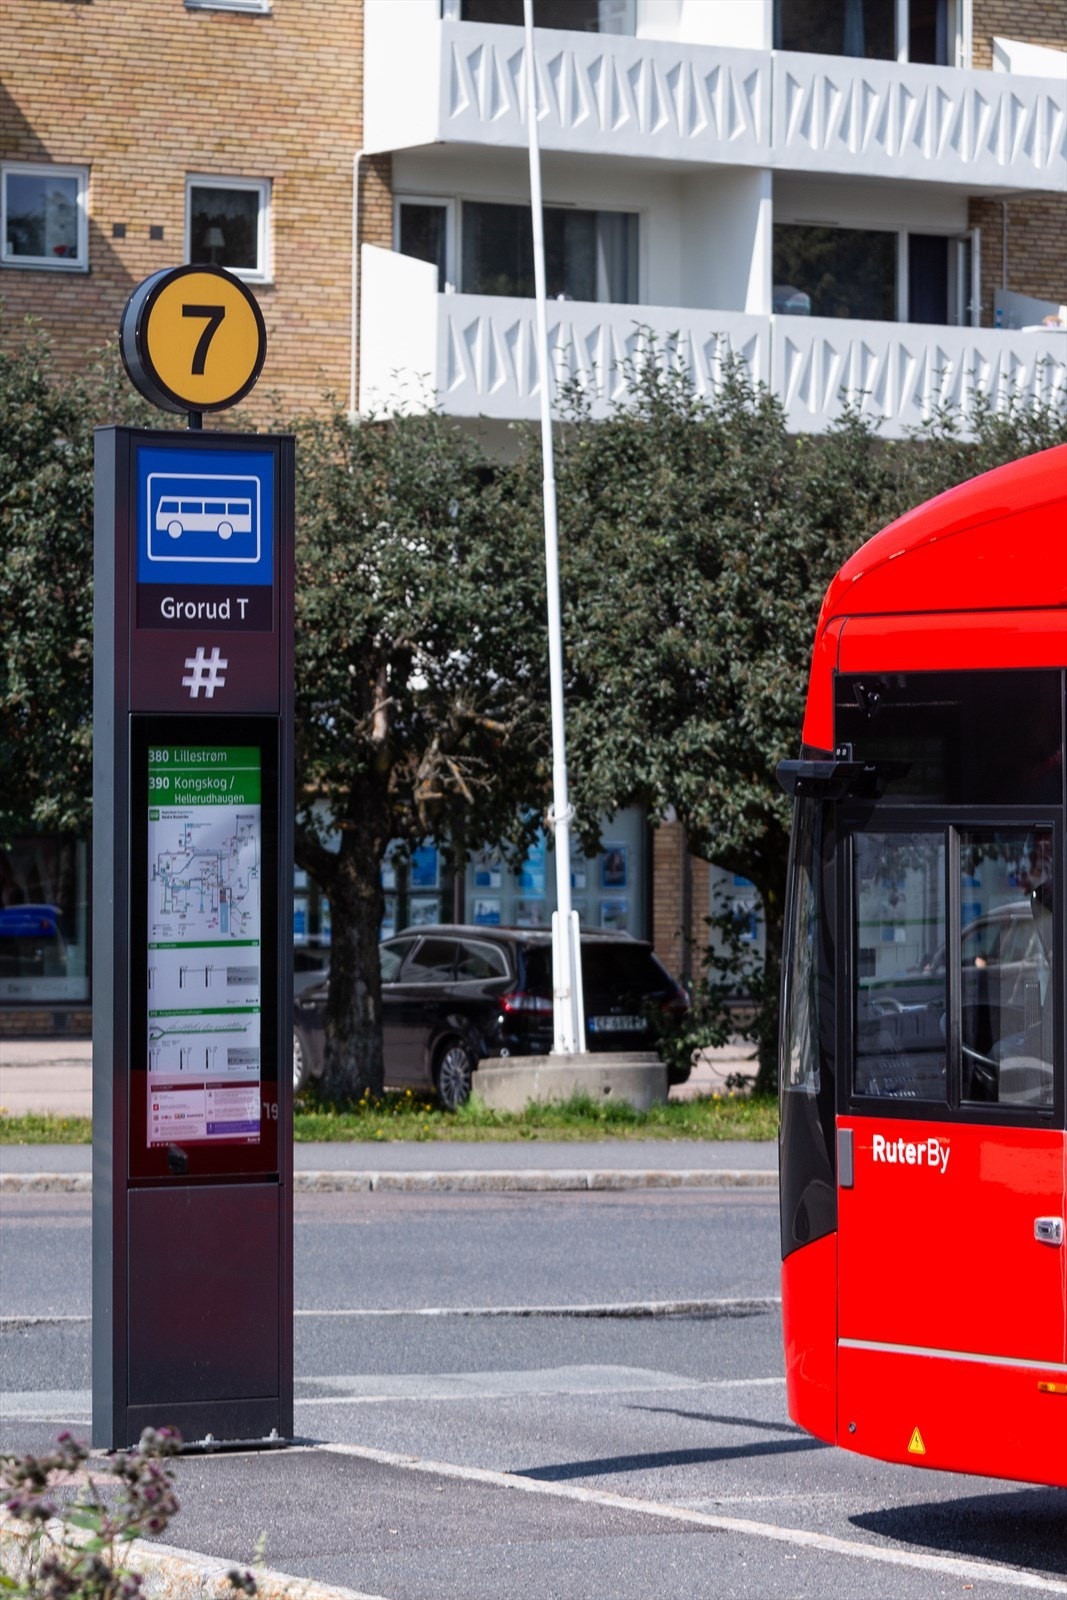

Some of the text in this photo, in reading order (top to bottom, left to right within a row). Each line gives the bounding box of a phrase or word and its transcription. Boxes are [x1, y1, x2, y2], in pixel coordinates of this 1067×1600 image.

[181, 304, 225, 375] 7
[160, 597, 249, 620] Grorud T
[148, 749, 227, 762] 380 Lillestrøm
[149, 776, 170, 789] 390
[174, 776, 227, 792] Kongskog
[174, 793, 245, 805] Hellerudhaugen
[872, 1134, 951, 1175] RuterBy
